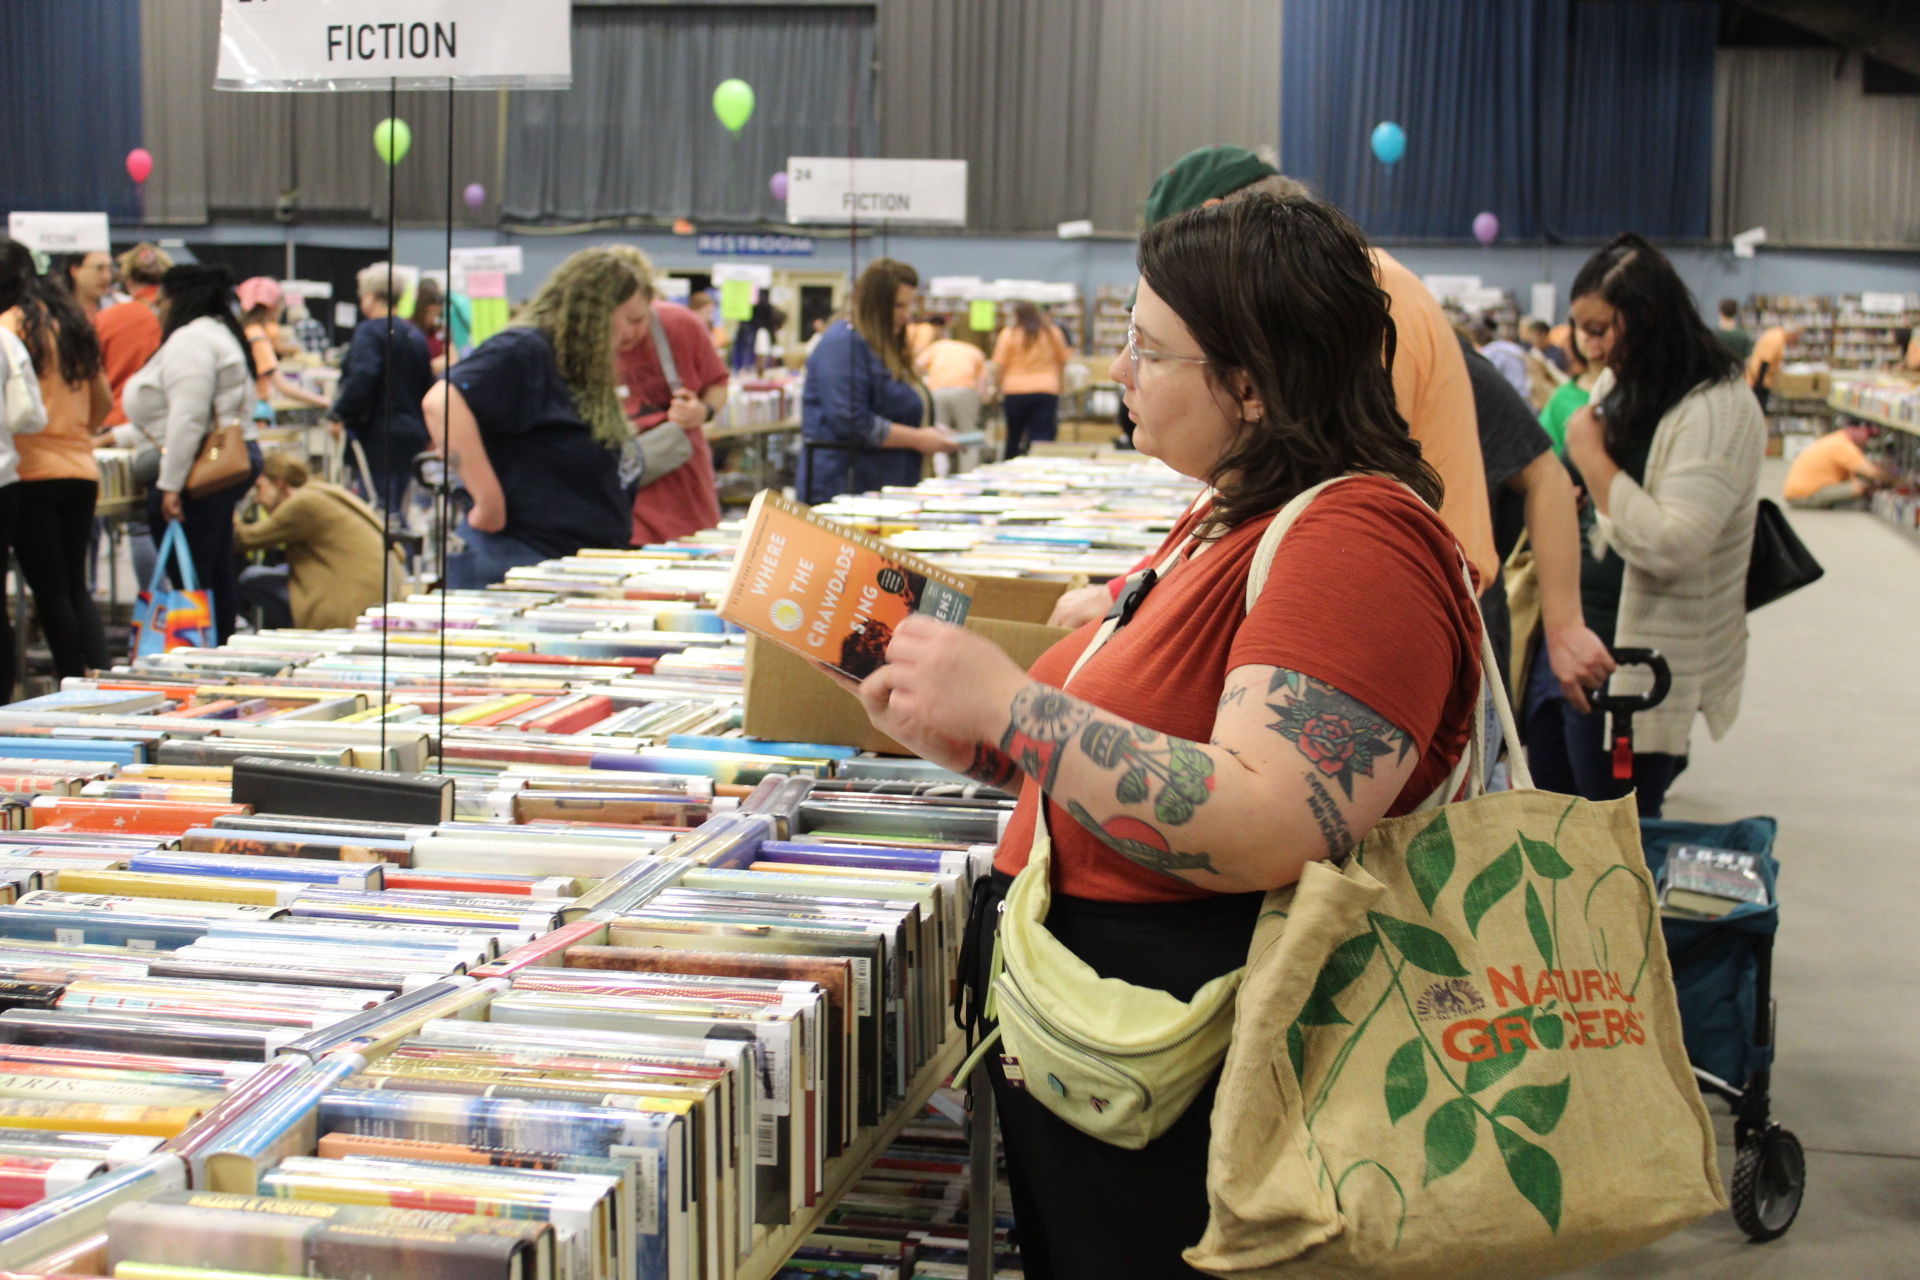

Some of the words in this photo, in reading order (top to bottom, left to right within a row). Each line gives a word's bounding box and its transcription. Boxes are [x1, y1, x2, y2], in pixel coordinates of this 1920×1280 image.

[327, 21, 457, 61] FICTION
[842, 192, 910, 211] FICTION
[750, 532, 787, 596] WHERE
[775, 498, 800, 516] THE
[892, 551, 966, 590] SENSATION
[789, 557, 815, 594] THE
[806, 543, 855, 648] CRAWDADS
[850, 584, 879, 635] SING
[294, 762, 331, 770] STATE
[351, 768, 401, 778] TERROR
[0, 1076, 81, 1092] ARIS
